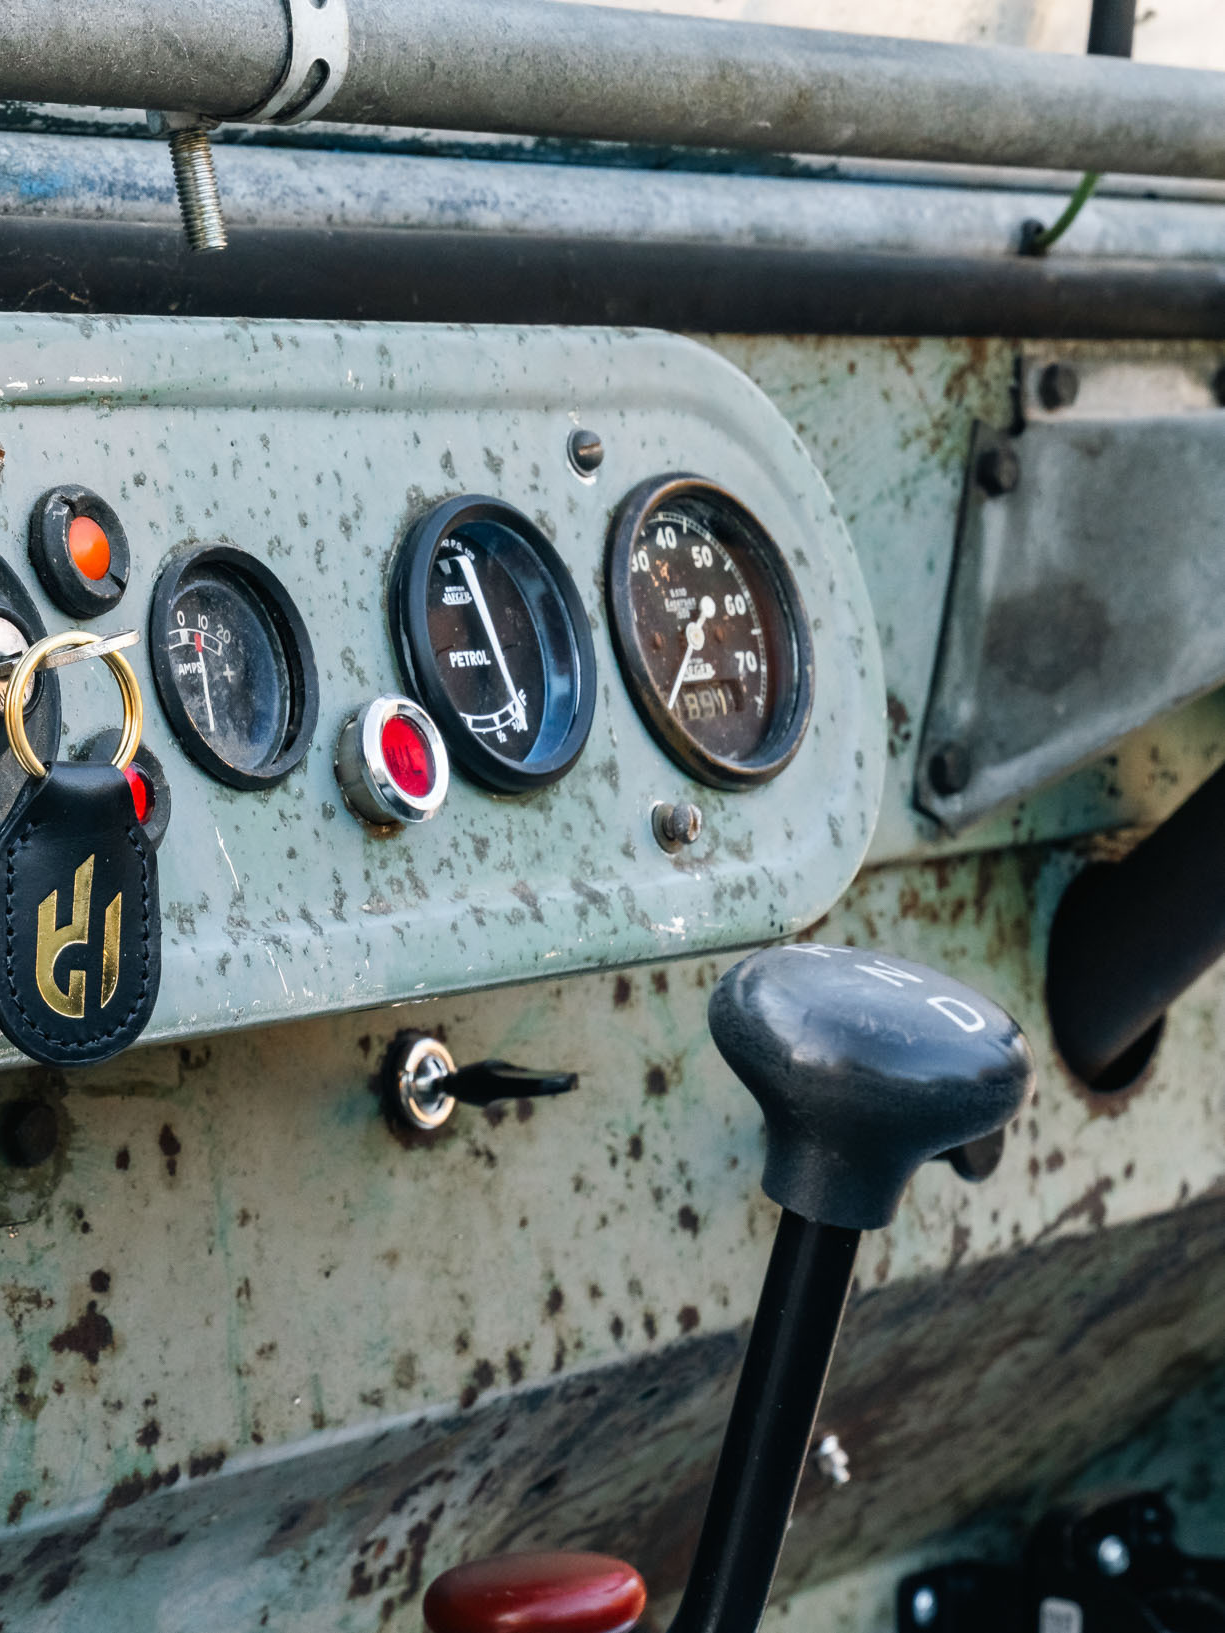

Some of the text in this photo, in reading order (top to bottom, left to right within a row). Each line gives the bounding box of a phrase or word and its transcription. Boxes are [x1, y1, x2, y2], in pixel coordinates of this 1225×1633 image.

[656, 526, 677, 549] 40
[691, 545, 713, 568] 50
[724, 594, 746, 616] 60
[176, 610, 186, 627] 0
[197, 613, 209, 631] 10
[216, 623, 231, 644] 20
[178, 661, 204, 676] AMPS
[449, 649, 491, 668] PETROL
[734, 650, 757, 673] 70
[517, 688, 527, 706] F
[782, 942, 986, 1033] R N D
